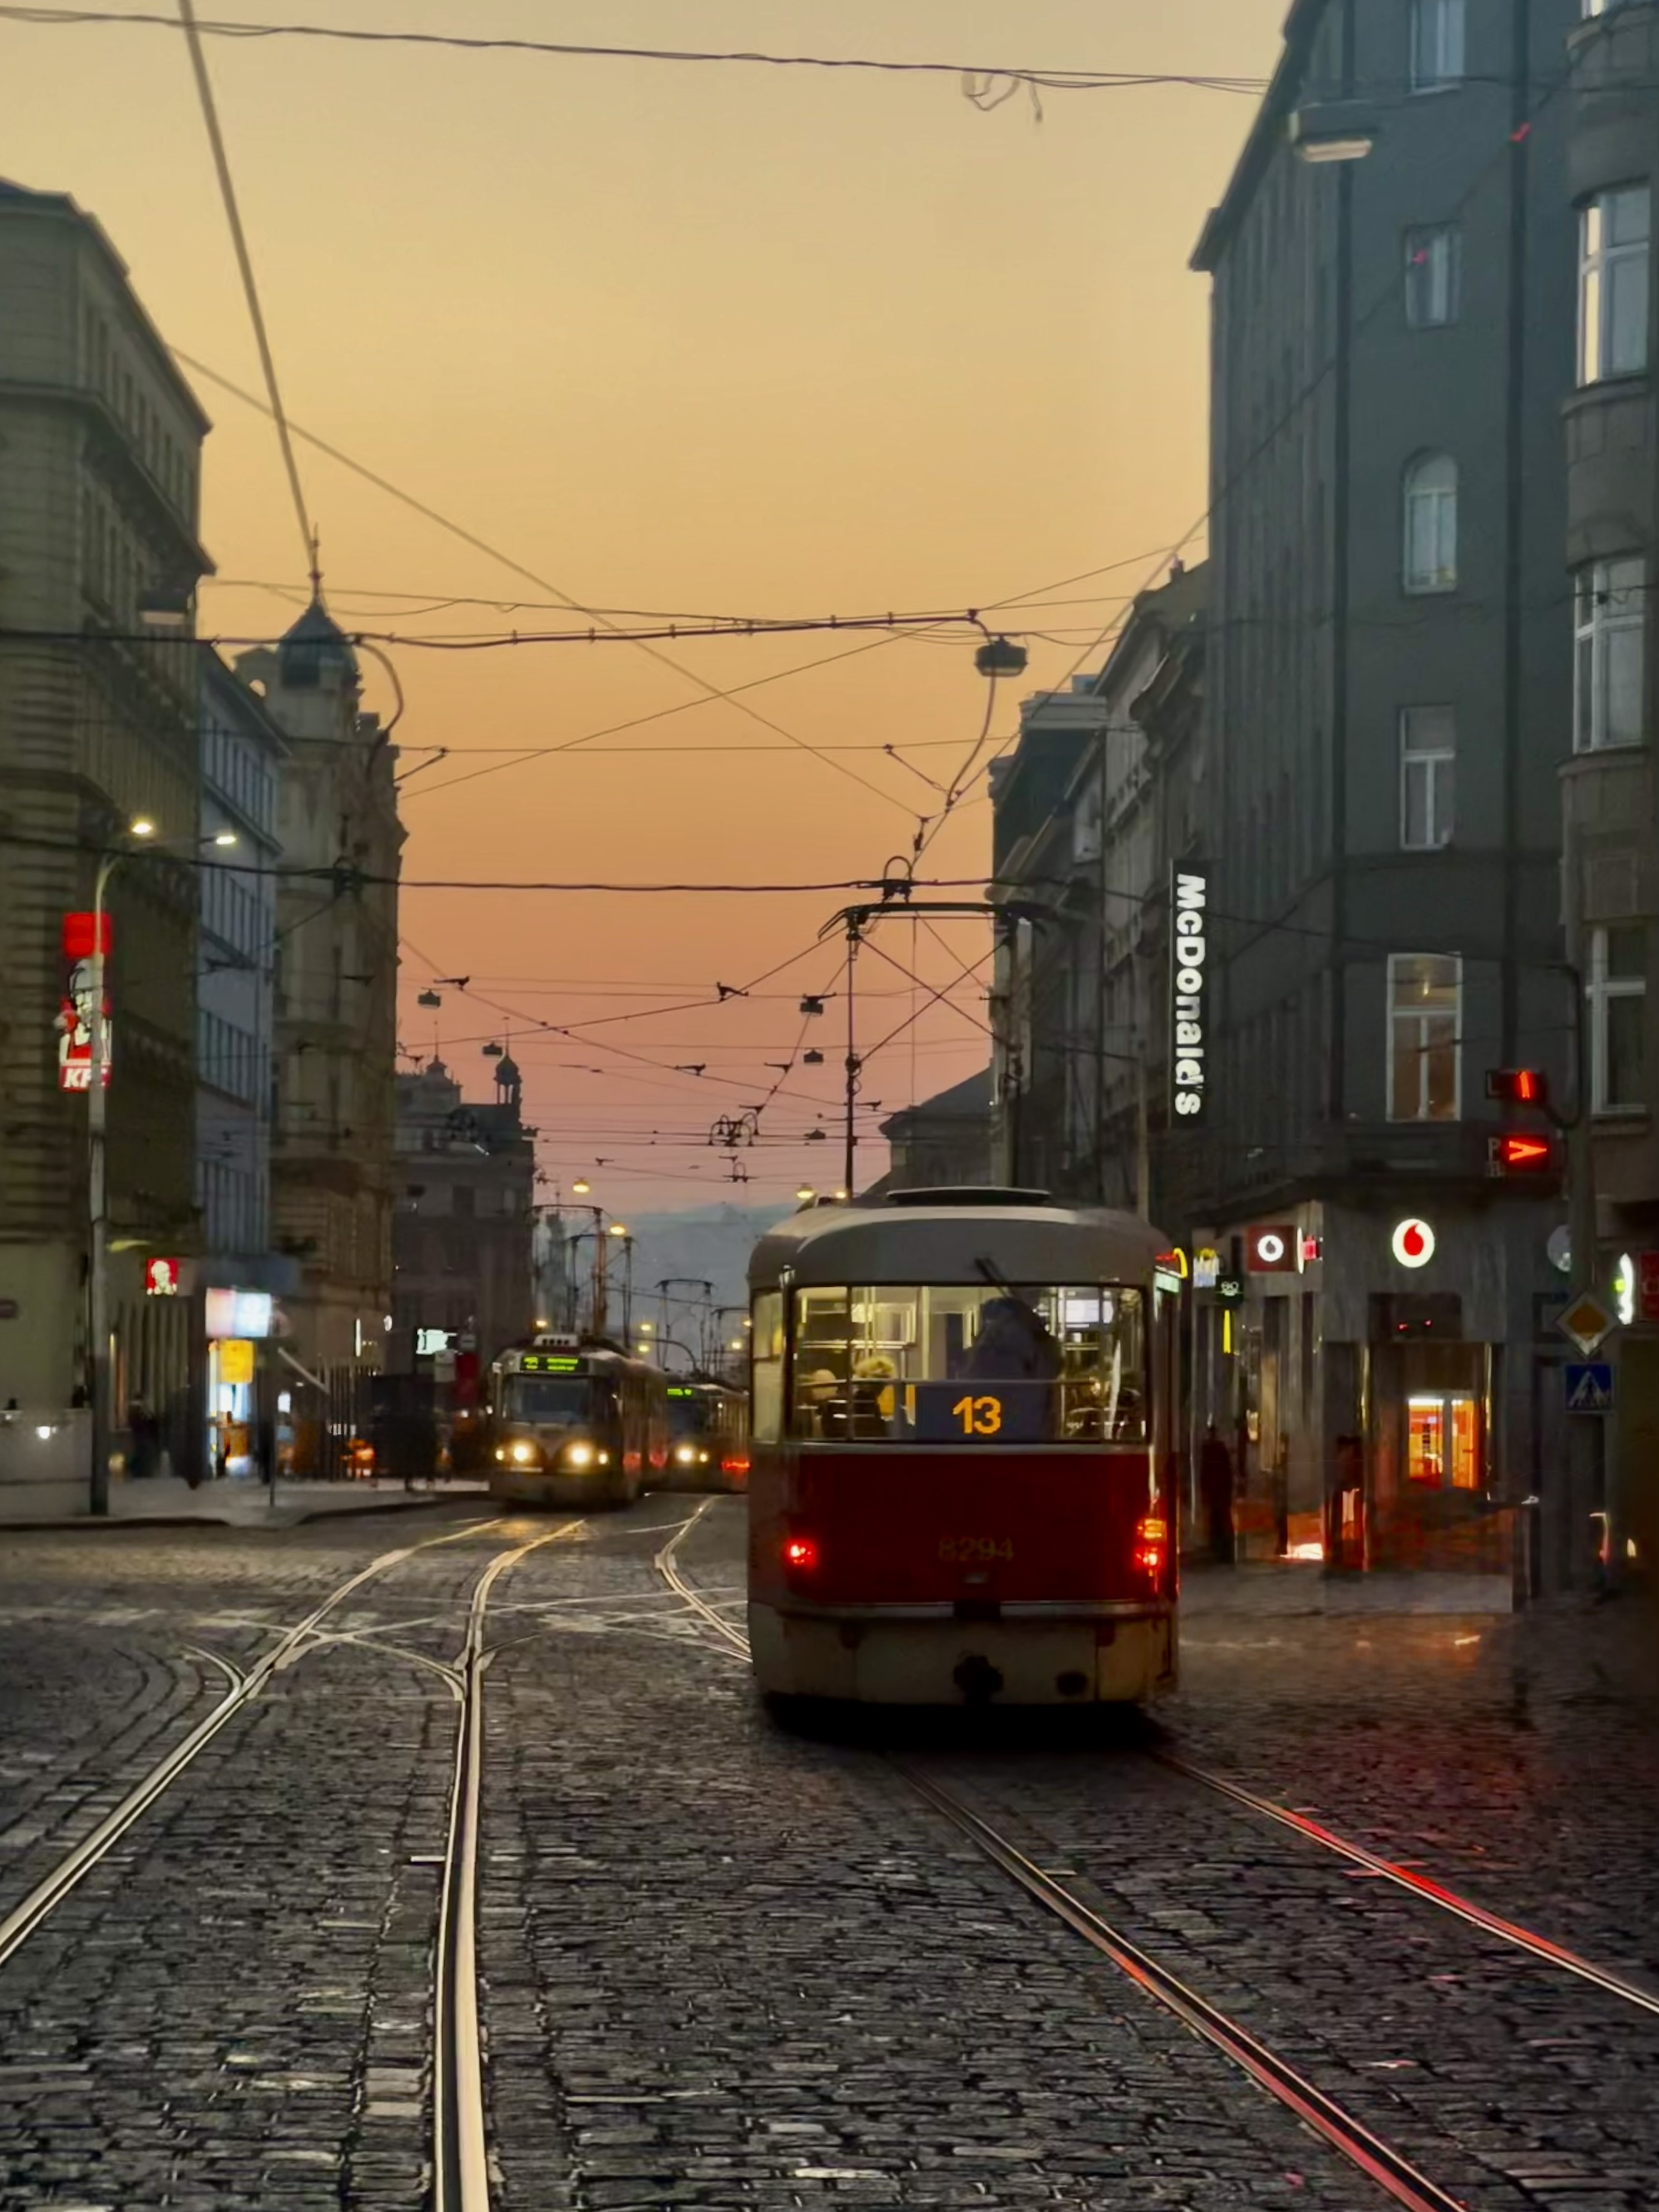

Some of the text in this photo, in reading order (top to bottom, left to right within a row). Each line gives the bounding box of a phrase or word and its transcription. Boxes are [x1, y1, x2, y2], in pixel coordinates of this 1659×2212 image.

[1174, 873, 1206, 1115] McDonald's
[952, 1396, 1001, 1434] 13
[937, 1535, 1015, 1562] 8294
